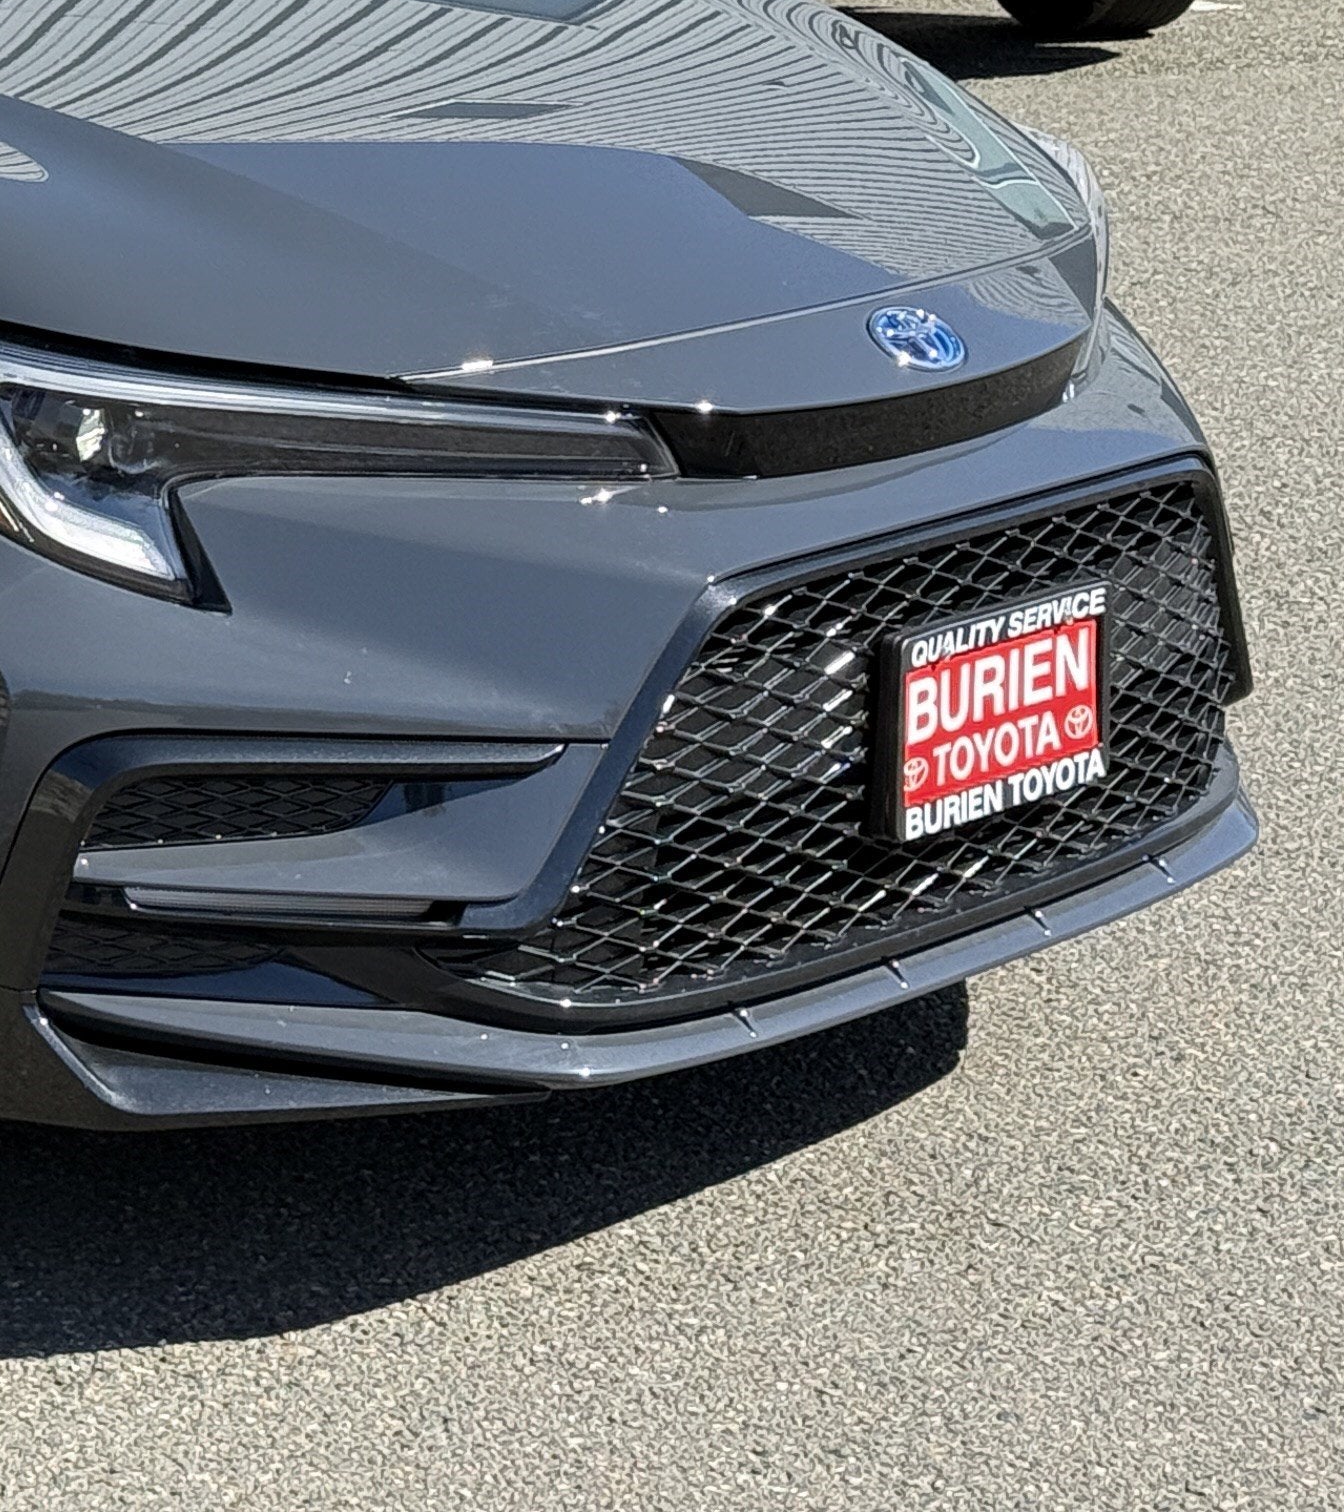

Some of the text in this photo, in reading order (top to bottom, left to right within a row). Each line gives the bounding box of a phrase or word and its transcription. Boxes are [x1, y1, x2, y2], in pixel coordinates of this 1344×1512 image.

[912, 587, 1107, 668] QUALITY SERVICE
[906, 627, 1090, 744] BURIEN
[933, 710, 1061, 787] TOYOTA
[906, 748, 1107, 840] BURIEN TOYOTA
